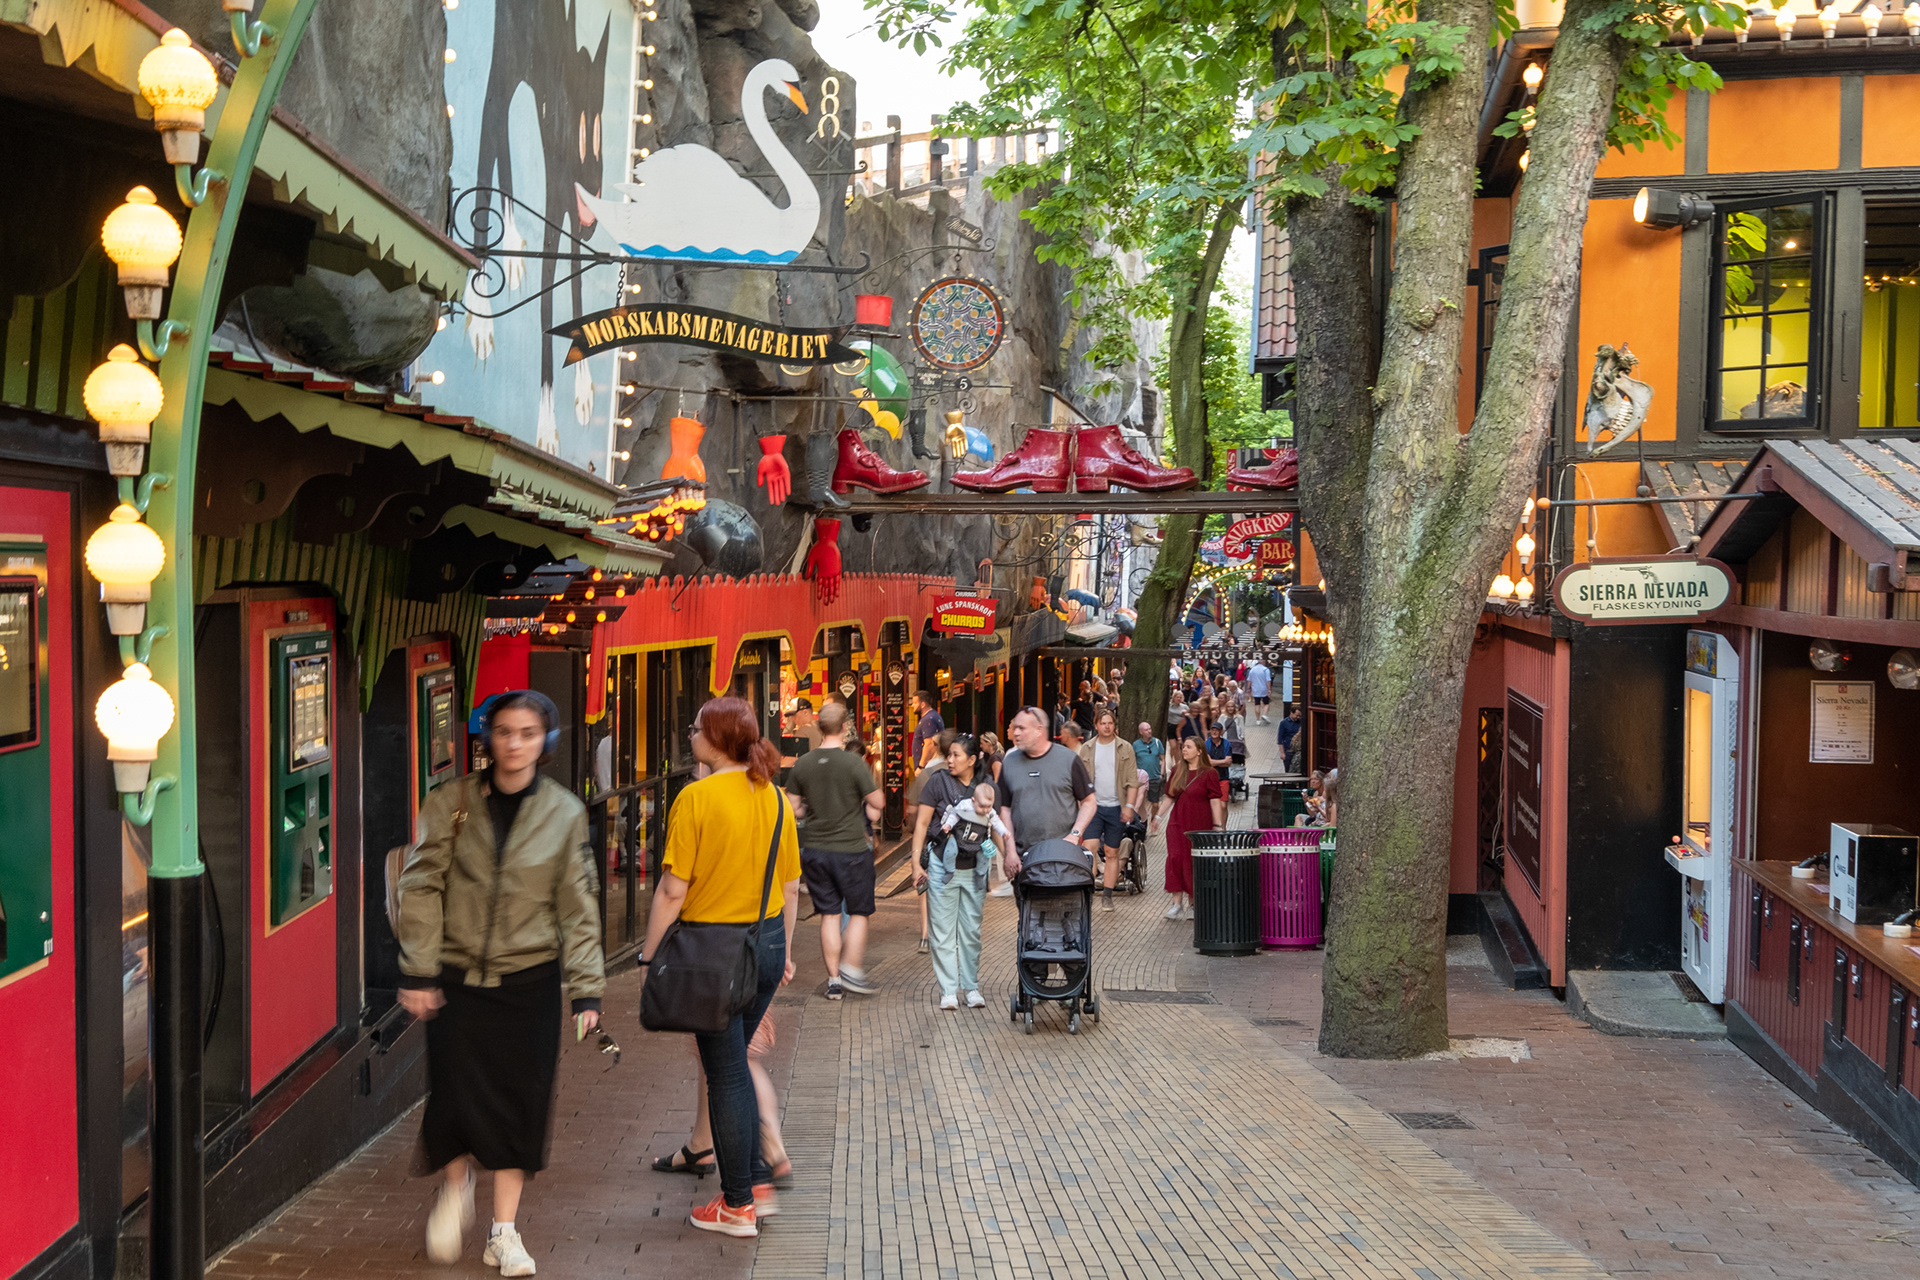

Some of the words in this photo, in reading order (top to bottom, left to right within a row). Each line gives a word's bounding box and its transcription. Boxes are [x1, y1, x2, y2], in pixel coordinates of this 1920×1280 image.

[582, 311, 828, 359] MORSKABSMENAGERIET
[959, 378, 968, 390] 5
[1263, 542, 1295, 559] BAR
[1579, 584, 1637, 602] SIERRA
[1644, 581, 1709, 600] NEVADA
[936, 602, 953, 613] LUNE
[1593, 600, 1702, 611] FLASKESKYDNING
[940, 614, 986, 628] CHURROS
[1183, 651, 1280, 660] SMUGKRO
